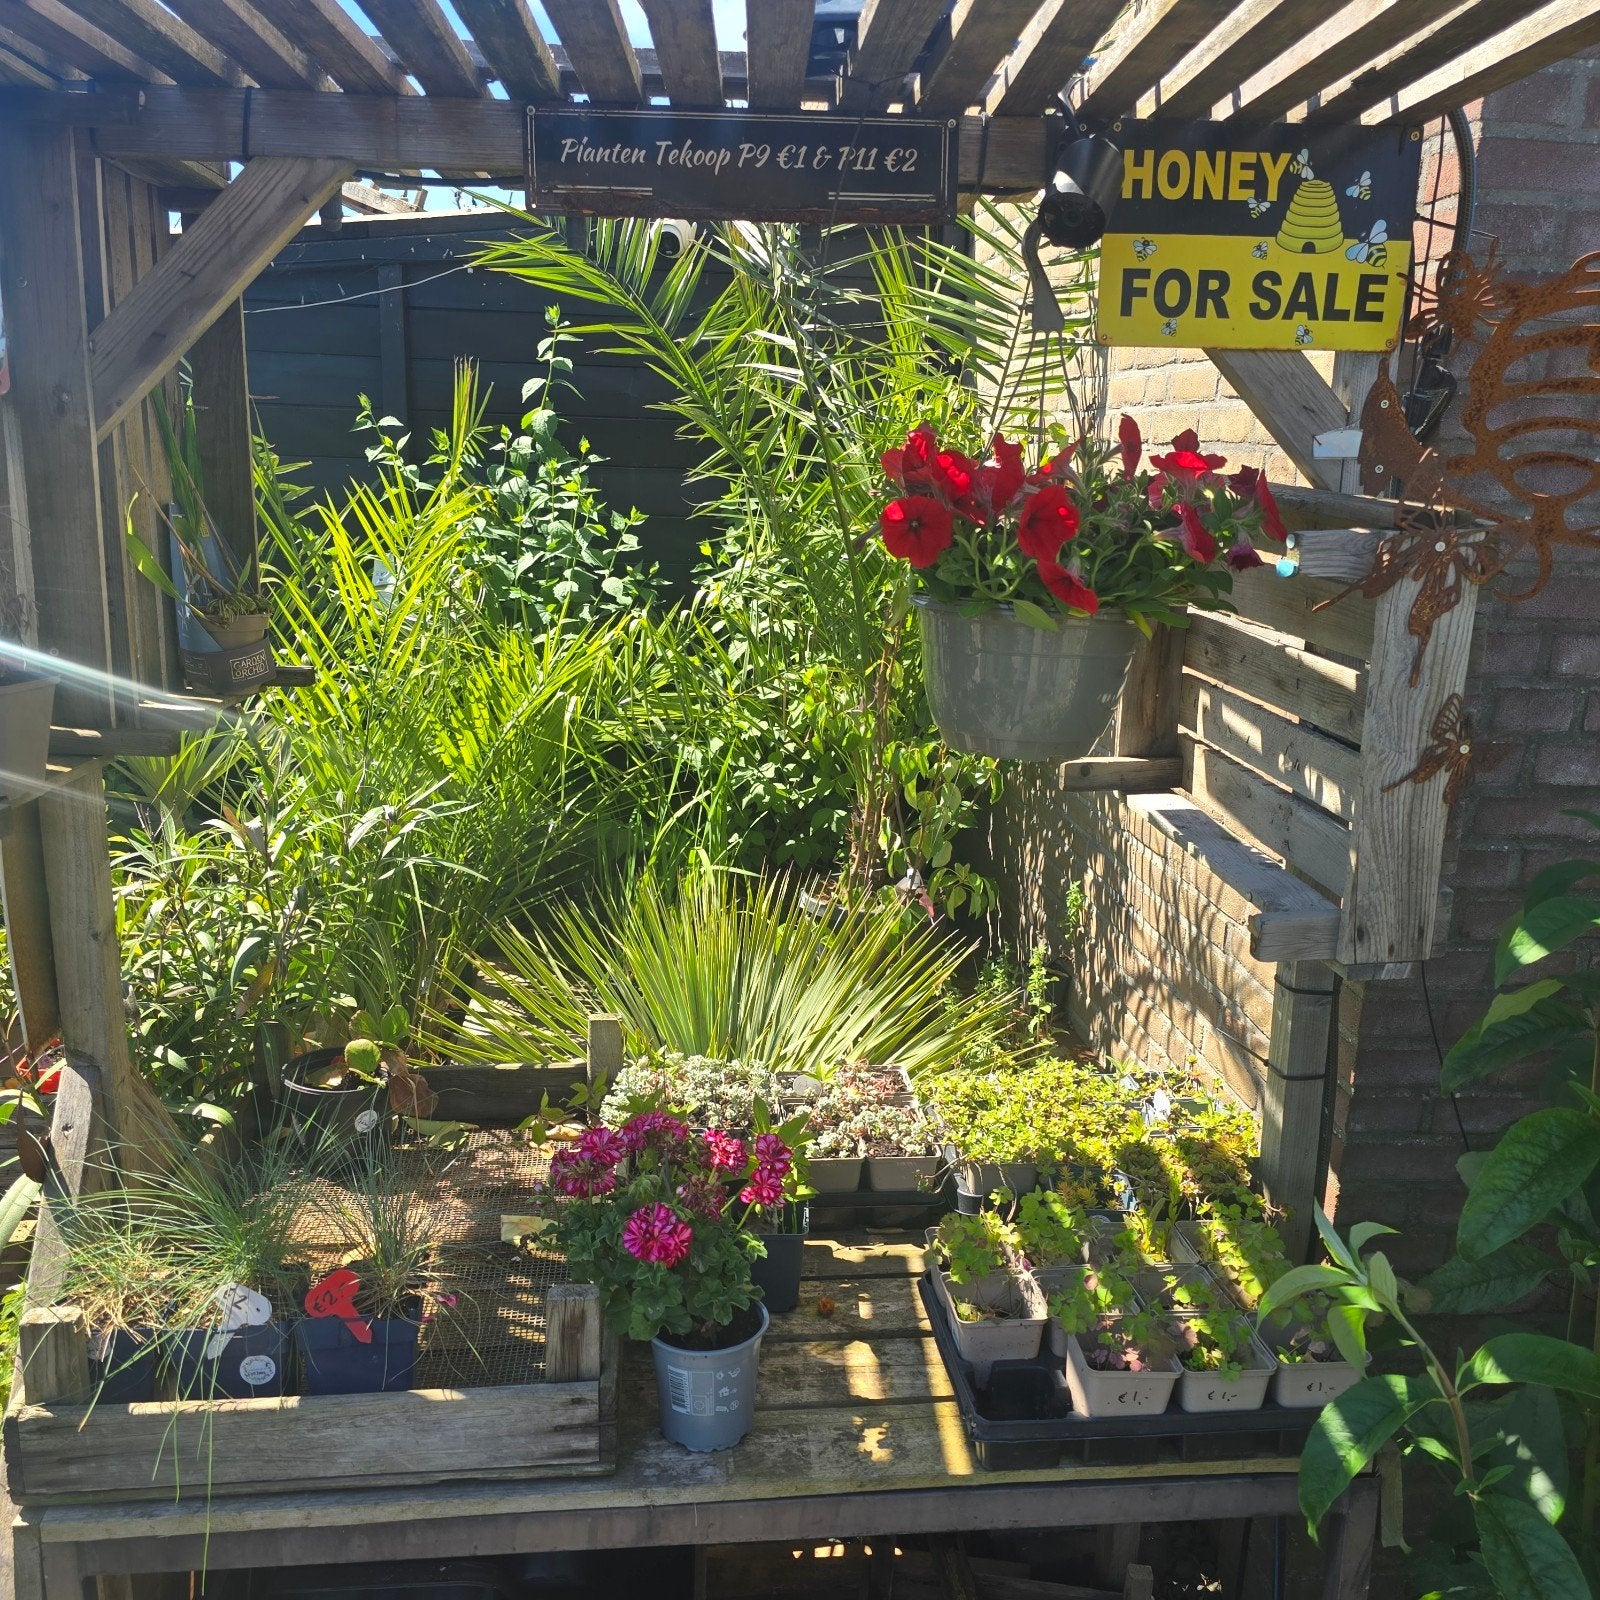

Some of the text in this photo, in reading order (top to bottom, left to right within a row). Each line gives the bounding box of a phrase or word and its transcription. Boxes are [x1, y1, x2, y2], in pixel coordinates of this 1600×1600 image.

[560, 136, 918, 175] Planten Tekoop P9 €1 & P11 €2
[1121, 149, 1292, 201] HONEY
[1120, 268, 1389, 322] FOR SALE
[233, 652, 266, 670] GARDEN
